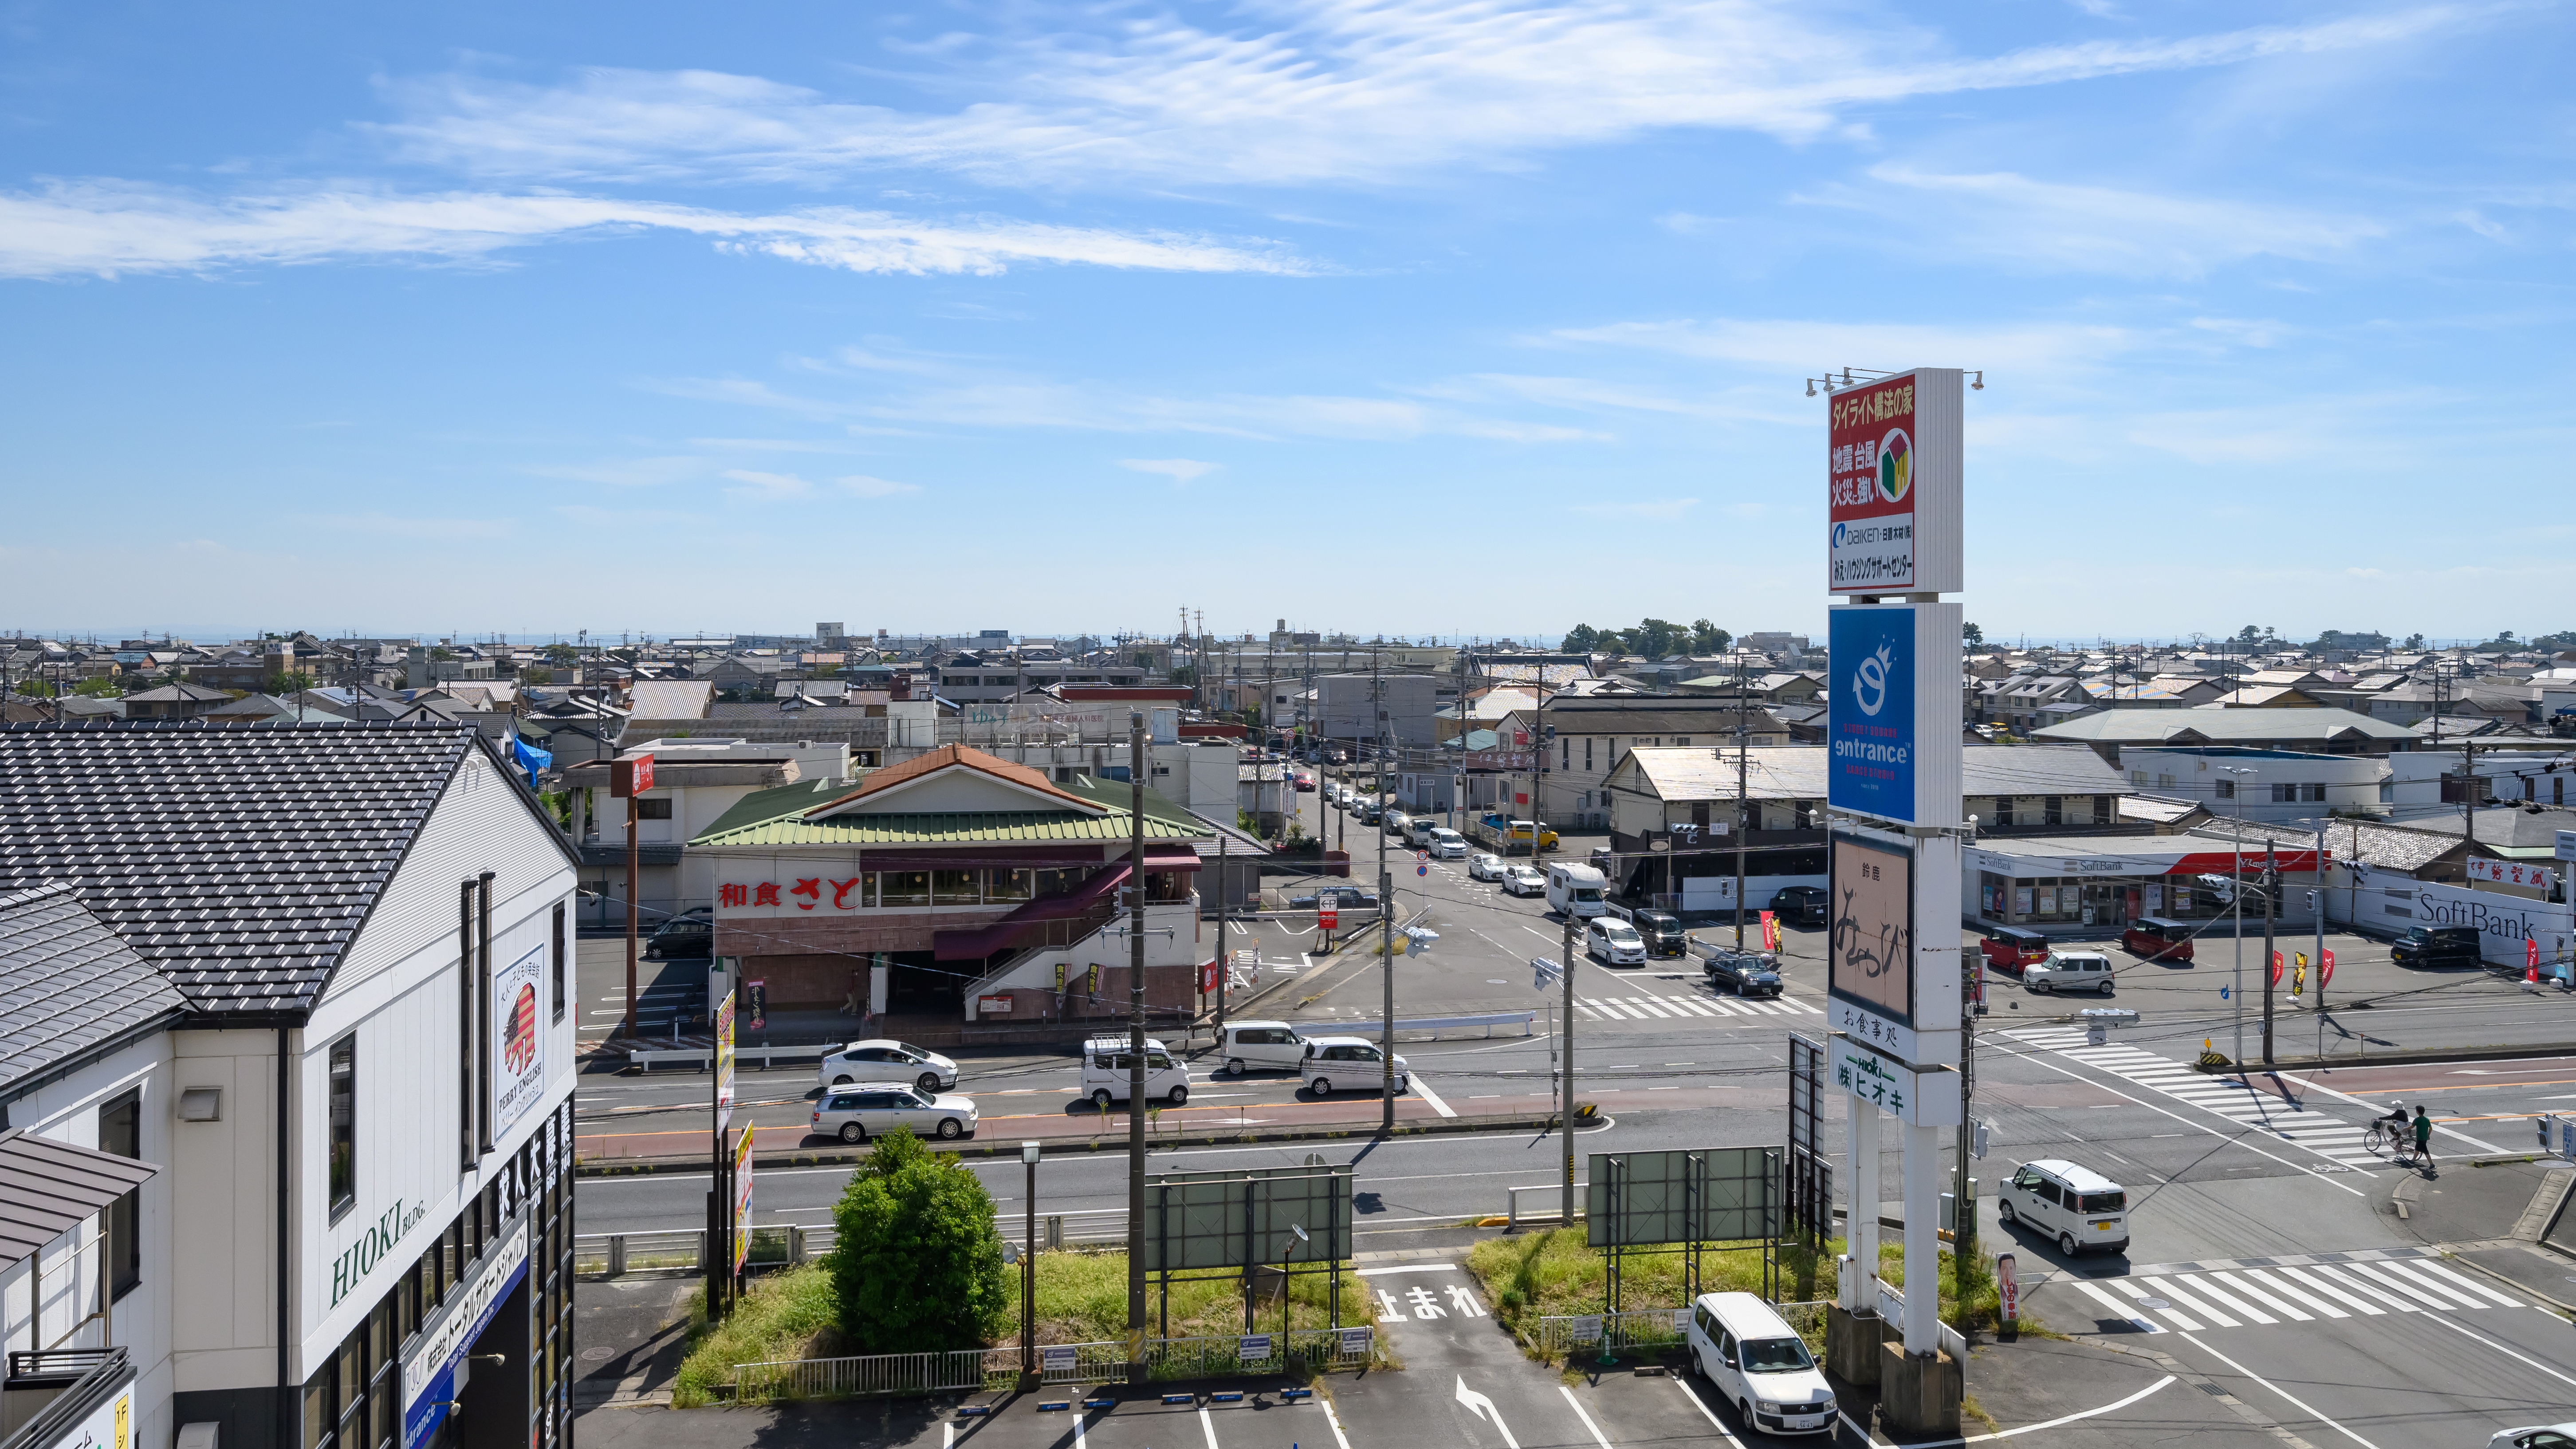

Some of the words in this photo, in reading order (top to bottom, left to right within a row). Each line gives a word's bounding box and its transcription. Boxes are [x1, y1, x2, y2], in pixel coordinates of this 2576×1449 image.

[1833, 384, 1912, 431] ダイライト構法の家
[1833, 445, 1853, 474] 地震
[1855, 440, 1876, 470] 台風
[1844, 723, 1868, 735] STREET
[1870, 726, 1897, 738] SQUARE
[1846, 764, 1867, 777] DANCE
[1869, 768, 1895, 780] STUDIO
[1862, 862, 1880, 882] 鈴鹿
[1987, 857, 2012, 871] SoftBank
[2080, 860, 2124, 871] SoftBank
[717, 877, 860, 910] 和食さと
[1329, 899, 1336, 909] P
[1835, 878, 1908, 978] みやび
[2419, 893, 2535, 941] SoftBank
[1844, 1007, 1897, 1047] お食事処
[1858, 1056, 1882, 1079] HIOKI
[499, 1083, 517, 1114] PERRY
[519, 1061, 542, 1089] ENGLISH
[330, 1197, 403, 1311] HIOKI
[1376, 1285, 1487, 1323] 止まれ
[448, 1348, 458, 1371] Total
[459, 1327, 476, 1356] Support
